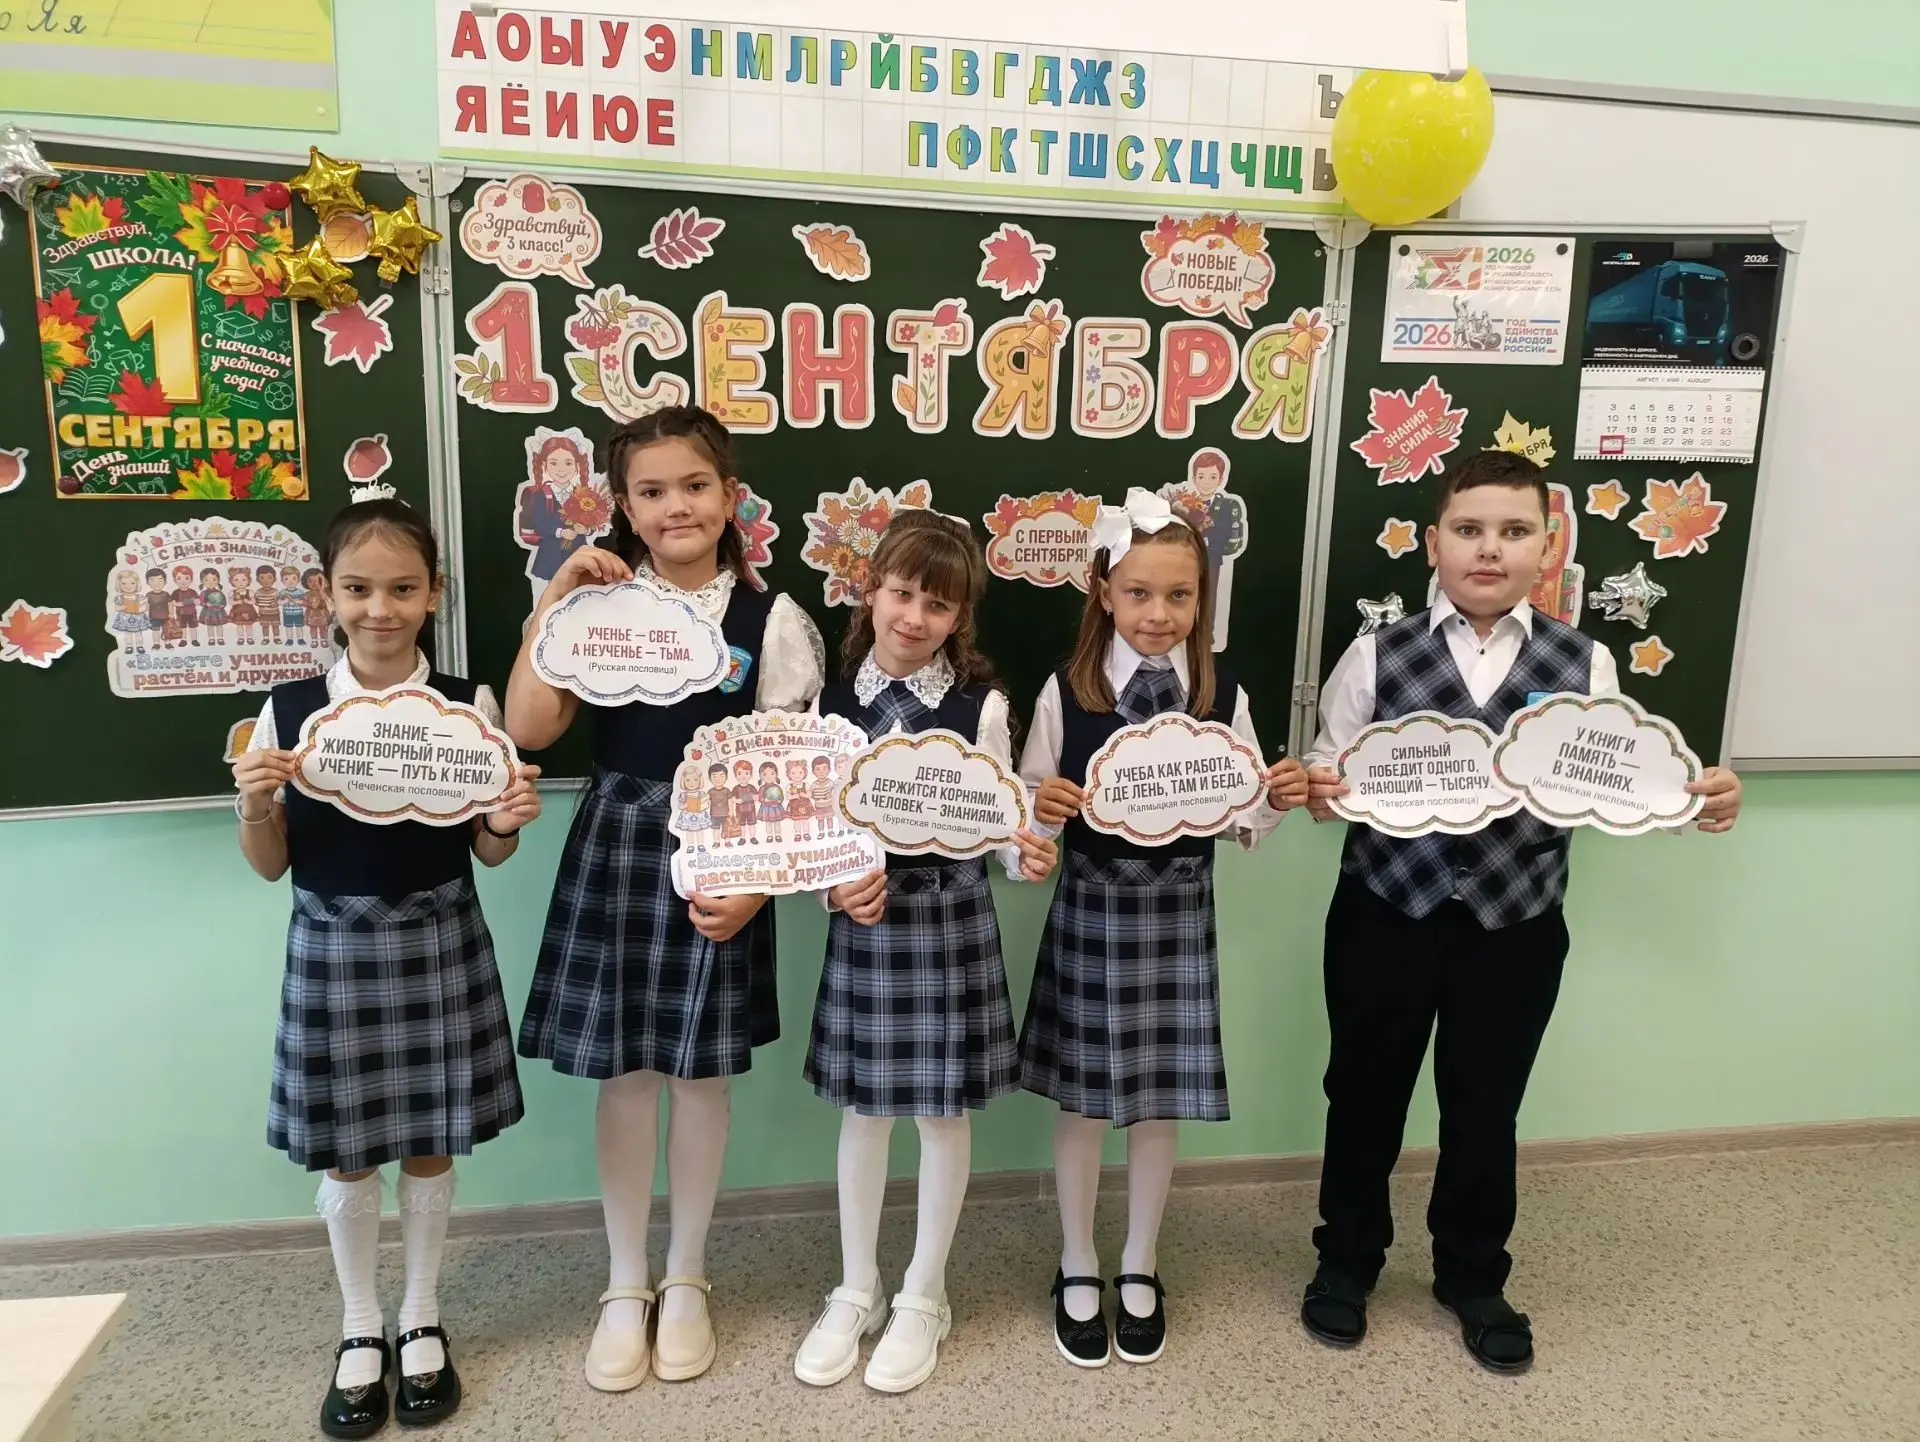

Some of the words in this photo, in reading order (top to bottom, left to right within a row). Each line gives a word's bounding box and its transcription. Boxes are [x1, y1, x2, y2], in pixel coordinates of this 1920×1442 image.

[484, 213, 591, 242] Здравствуй,
[43, 221, 151, 263] Здравствуй,
[508, 236, 514, 249] 3
[520, 240, 563, 252] класс!
[86, 247, 196, 271] ШКОЛА!
[1187, 253, 1236, 270] НОВЫЕ
[1487, 248, 1535, 263] 2026
[1744, 255, 1769, 263] 2026
[1178, 273, 1241, 293] ПОБЕДЫ!
[1505, 328, 1559, 336] ЕДИНСТВА
[1506, 319, 1526, 327] ГОД
[117, 272, 201, 403] 1
[1394, 324, 1451, 344] 2026
[1504, 337, 1552, 345] НАРОДОВ
[201, 333, 212, 347] С
[216, 339, 291, 366] началом
[210, 355, 279, 378] учебного
[471, 287, 552, 407] 1
[598, 304, 1312, 435] СЕНТЯБРЯ
[224, 373, 265, 392] года!
[58, 414, 295, 450] СЕНТЯБРЯ
[1383, 410, 1428, 448] ЗНАНИЯ
[1400, 425, 1435, 454] СИЛА!
[71, 451, 128, 481] День
[107, 460, 171, 485] знаний
[1016, 530, 1024, 543] С
[1029, 530, 1088, 544] ПЕРВЫМ
[159, 547, 169, 560] С
[1015, 548, 1088, 562] СЕНТЯБРЯ!
[588, 627, 632, 641] УЧЕНЬЕ
[649, 630, 680, 645] СВЕТ,
[126, 654, 222, 670] «Вместе
[229, 651, 318, 670] учимся,
[572, 644, 579, 656] А
[584, 644, 642, 659] НЕУЧЕНЬЕ
[661, 647, 693, 661] ТЬМА.
[589, 663, 626, 673] (Русская
[629, 664, 677, 674] пословица)
[133, 670, 216, 690] растём
[220, 672, 230, 683] и
[373, 722, 429, 742] ЗНАНИЕ
[1575, 727, 1587, 741] У
[1587, 729, 1636, 754] КНИГИ
[321, 737, 432, 762] ЖИВОТВОРНЫЙ
[437, 748, 495, 768] РОДНИК,
[721, 743, 732, 755] С
[1391, 742, 1450, 760] СИЛЬНЫЙ
[1559, 742, 1616, 769] ПАМЯТЬ
[319, 758, 374, 776] УЧЕНИЕ
[402, 764, 436, 781] ПУТЬ
[440, 767, 449, 782] К
[453, 769, 495, 785] НЕМУ.
[915, 766, 961, 784] ДЕРЕВО
[1115, 765, 1154, 783] УЧЕБА
[1158, 762, 1183, 778] КАК
[1186, 756, 1235, 775] РАБОТА:
[1369, 762, 1423, 778] ПОБЕДИТ
[1428, 759, 1479, 774] ОДНОГО,
[1553, 760, 1563, 775] В
[1566, 763, 1634, 793] ЗНАНИЯХ.
[348, 780, 404, 794] (Чеченская
[408, 786, 466, 799] пословица)
[872, 777, 936, 798] ДЕРЖИТСЯ
[940, 787, 998, 808] КОРНЯМИ,
[1105, 785, 1129, 803] ГДЕ
[1132, 782, 1168, 800] ЛЕНЬ,
[1171, 778, 1197, 794] ТАМ
[1200, 776, 1208, 790] И
[1212, 772, 1247, 790] БЕДА.
[1360, 777, 1423, 795] ЗНАЮЩИЙ
[1533, 776, 1592, 798] (Адыгейская
[1594, 791, 1649, 812] пословица)
[860, 793, 867, 806] А
[872, 794, 923, 813] ЧЕЛОВЕК
[940, 804, 1007, 825] ЗНАНИЯМИ.
[1128, 800, 1177, 815] (Калмыцкая
[1181, 793, 1227, 807] пословица)
[1428, 796, 1479, 806] пословица)
[883, 813, 929, 827] (Бурятская
[932, 822, 980, 836] пословица)
[688, 852, 780, 869] «Вместе
[694, 867, 772, 892] растём
[777, 869, 788, 883] и
[794, 850, 874, 884] дружим!»
